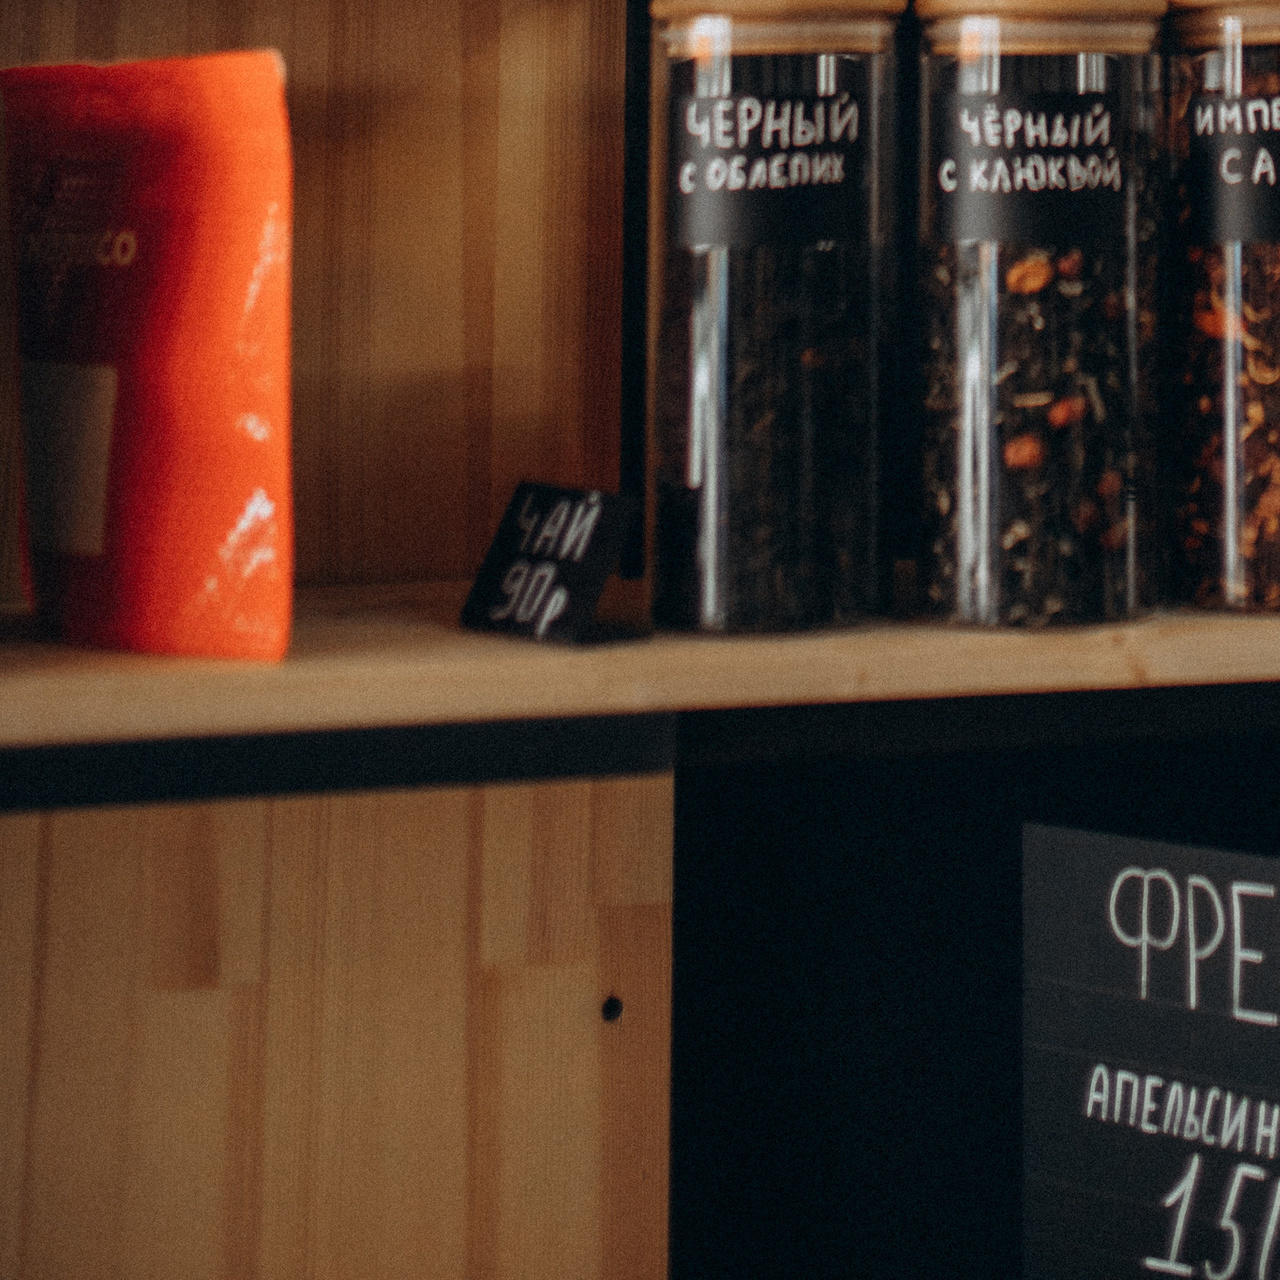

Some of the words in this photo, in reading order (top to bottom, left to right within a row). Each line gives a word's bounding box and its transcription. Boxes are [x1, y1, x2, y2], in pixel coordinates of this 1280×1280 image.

[685, 92, 859, 150] ЧЕРНЫЙ
[959, 102, 1111, 149] ЧЁРНЫЙ
[969, 146, 1122, 193] КЛЮКВОЙ
[518, 490, 602, 562] ЧАЙ
